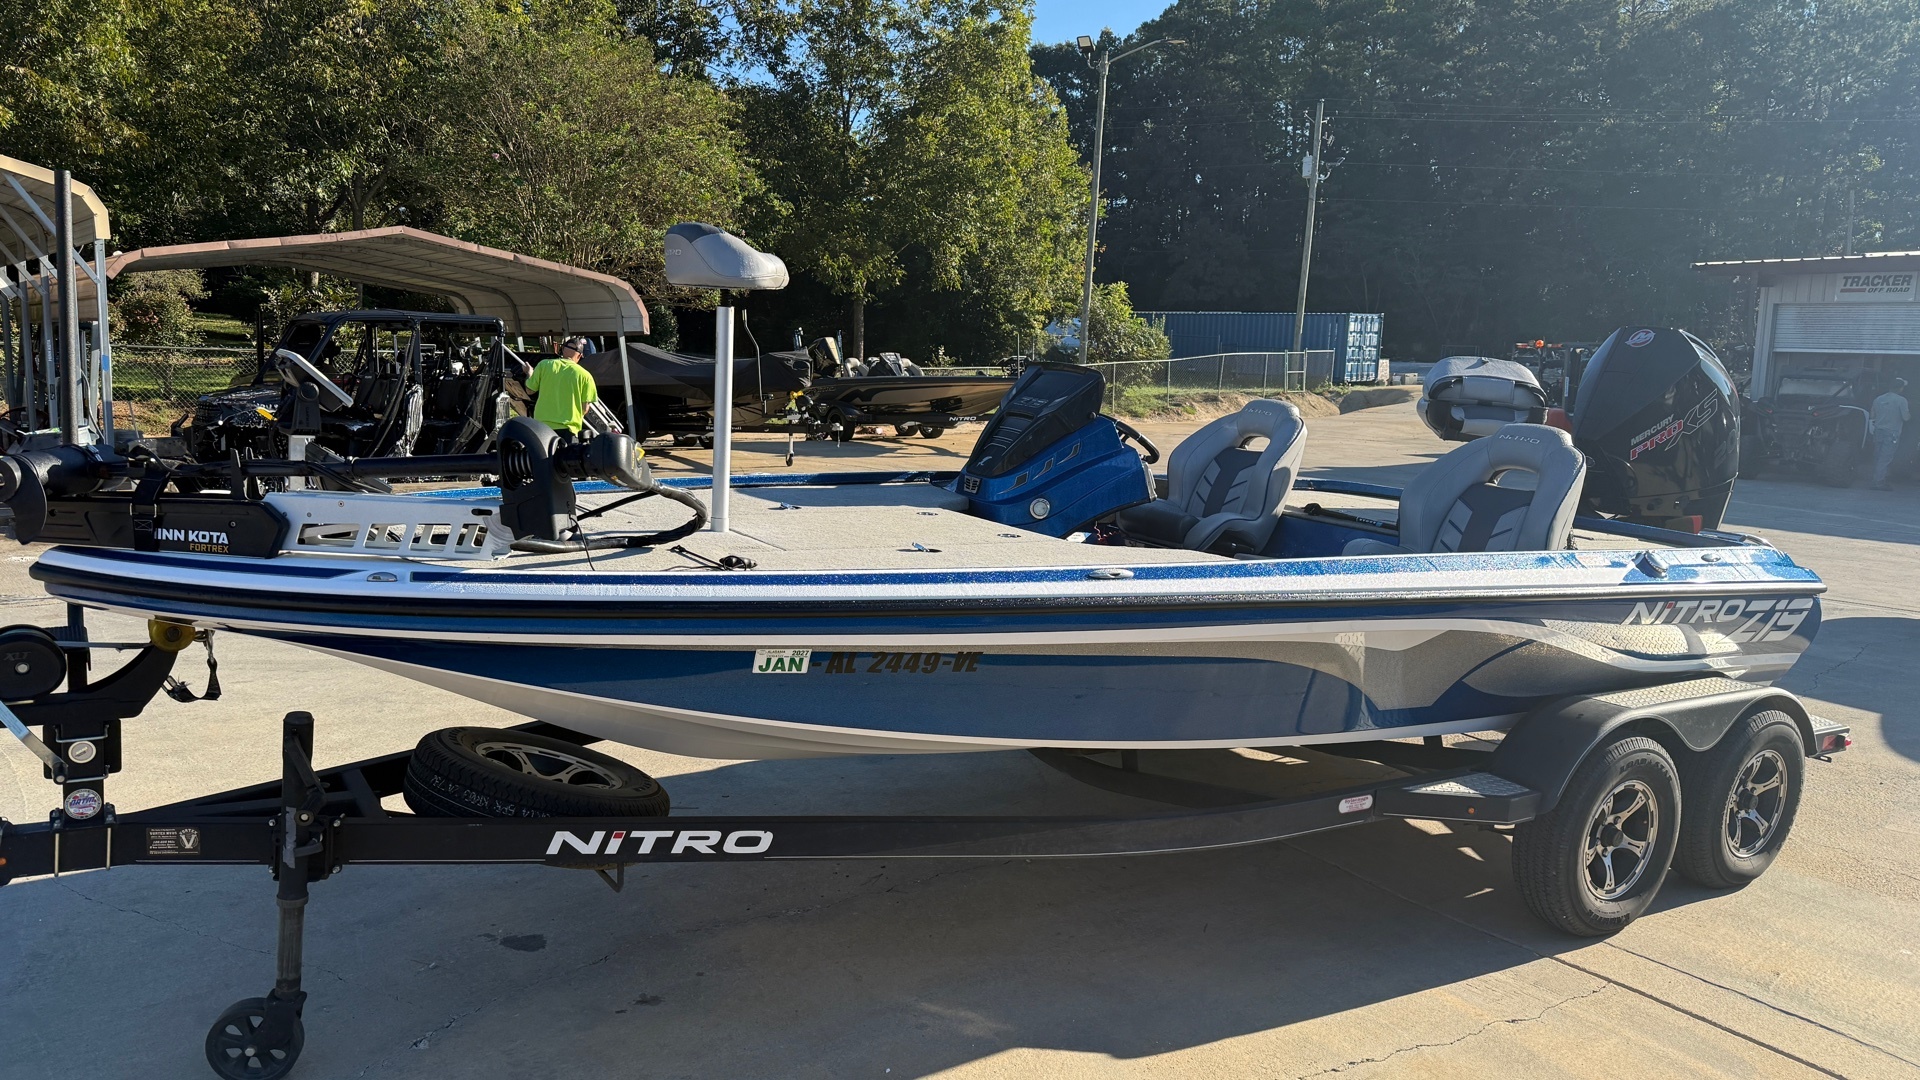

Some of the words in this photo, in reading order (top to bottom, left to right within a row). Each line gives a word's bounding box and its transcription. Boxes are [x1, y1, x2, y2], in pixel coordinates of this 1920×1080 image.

[1842, 274, 1913, 287] TRACKER
[1630, 414, 1675, 446] MERCURY
[1498, 434, 1540, 444] NITRO
[154, 527, 185, 541] INN
[188, 530, 229, 544] KOTA
[189, 543, 229, 553] FORTREX
[758, 657, 804, 672] JAN
[825, 651, 857, 673] AL
[867, 651, 984, 673] 2449-VE
[545, 830, 774, 855] NITRO
